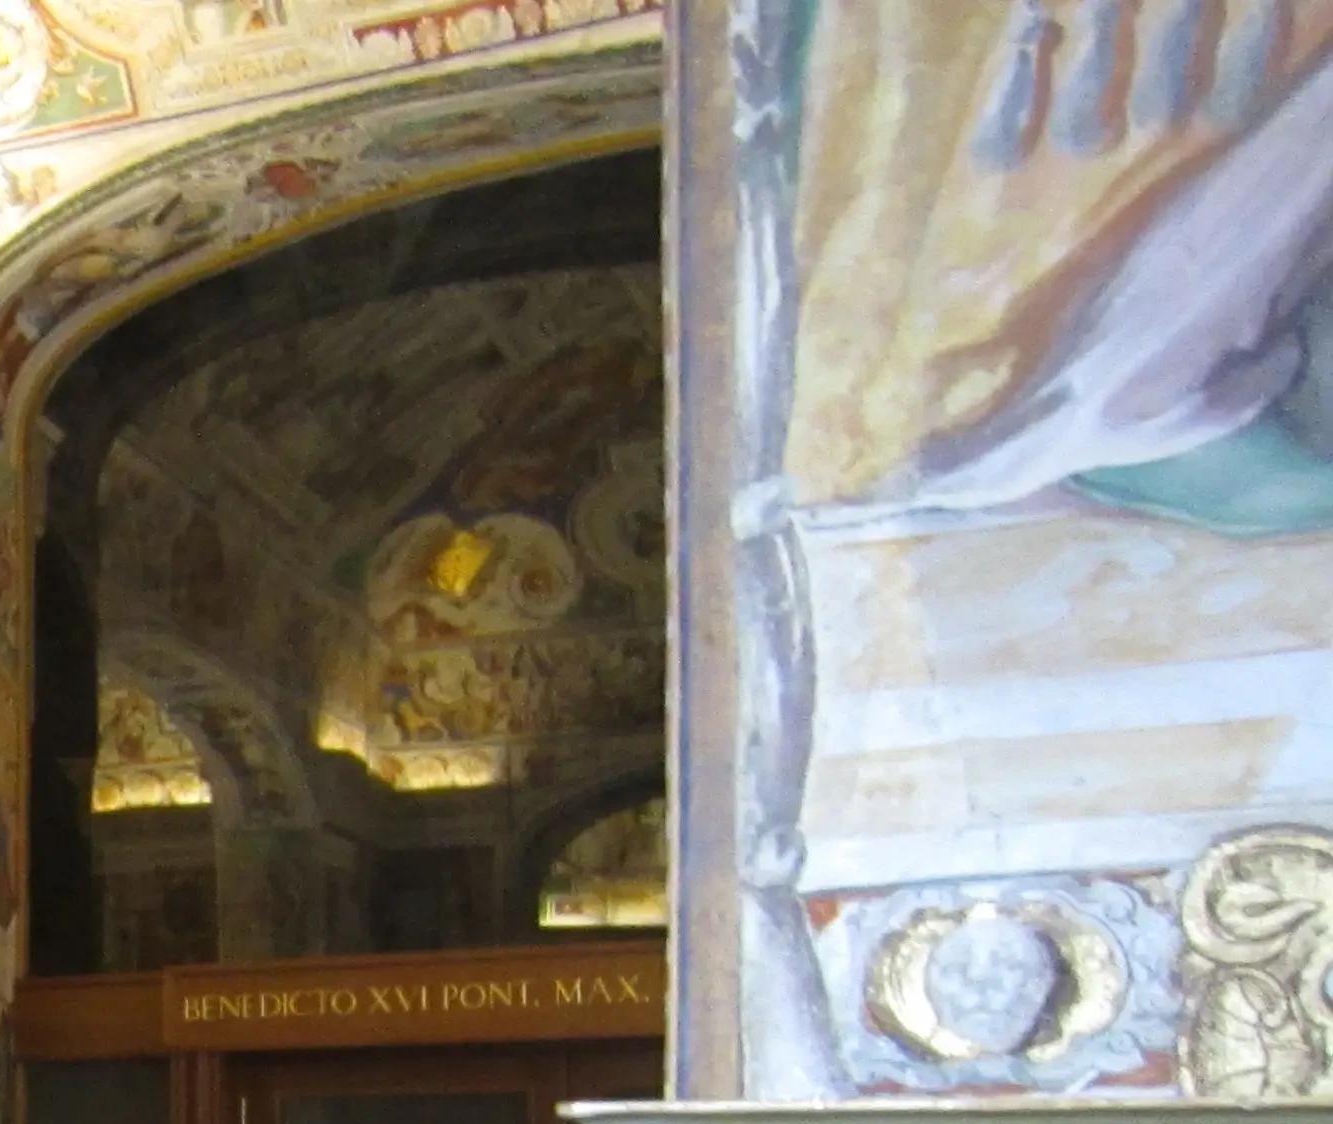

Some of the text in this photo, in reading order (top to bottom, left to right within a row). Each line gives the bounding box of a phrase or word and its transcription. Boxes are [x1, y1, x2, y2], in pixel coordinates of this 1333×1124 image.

[183, 973, 651, 1022] BENEDICTO XVI PONT. MAX.
